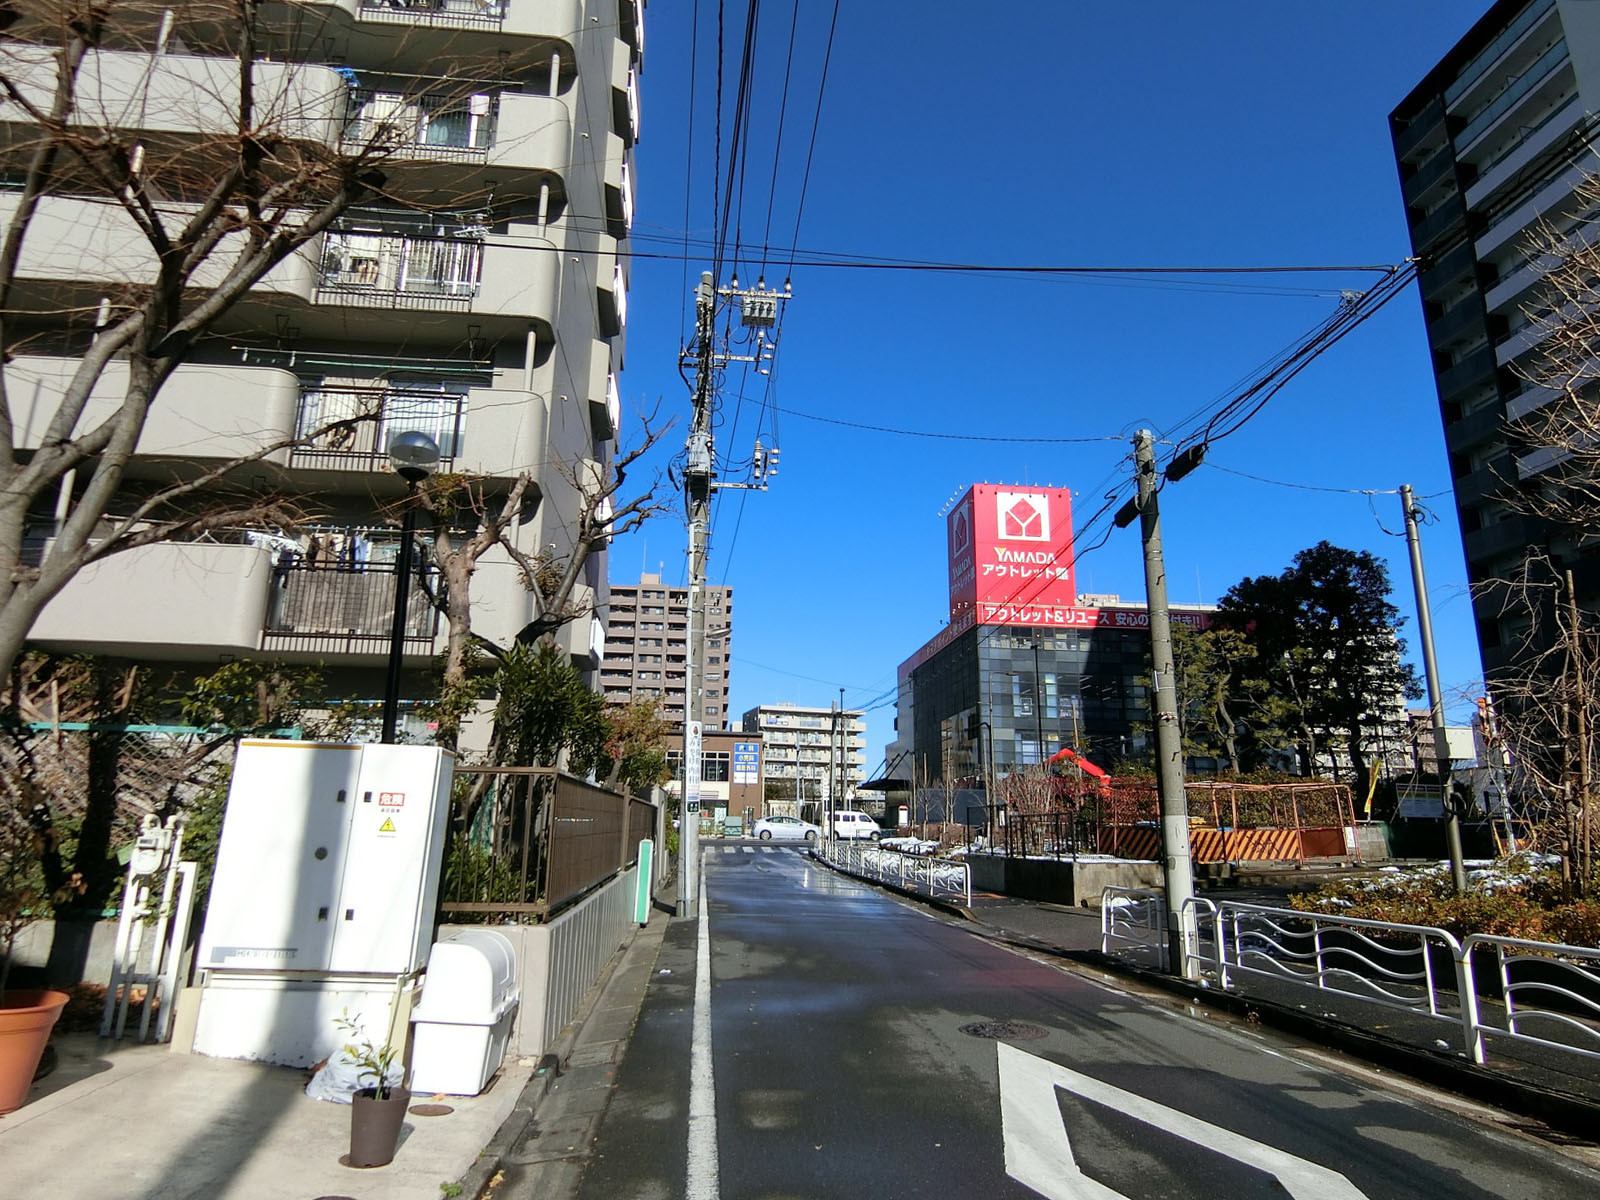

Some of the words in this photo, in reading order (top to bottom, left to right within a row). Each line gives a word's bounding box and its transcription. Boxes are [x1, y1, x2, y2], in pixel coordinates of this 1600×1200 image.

[994, 546, 1057, 565] YAMADA
[982, 563, 1069, 581] アウトレット館
